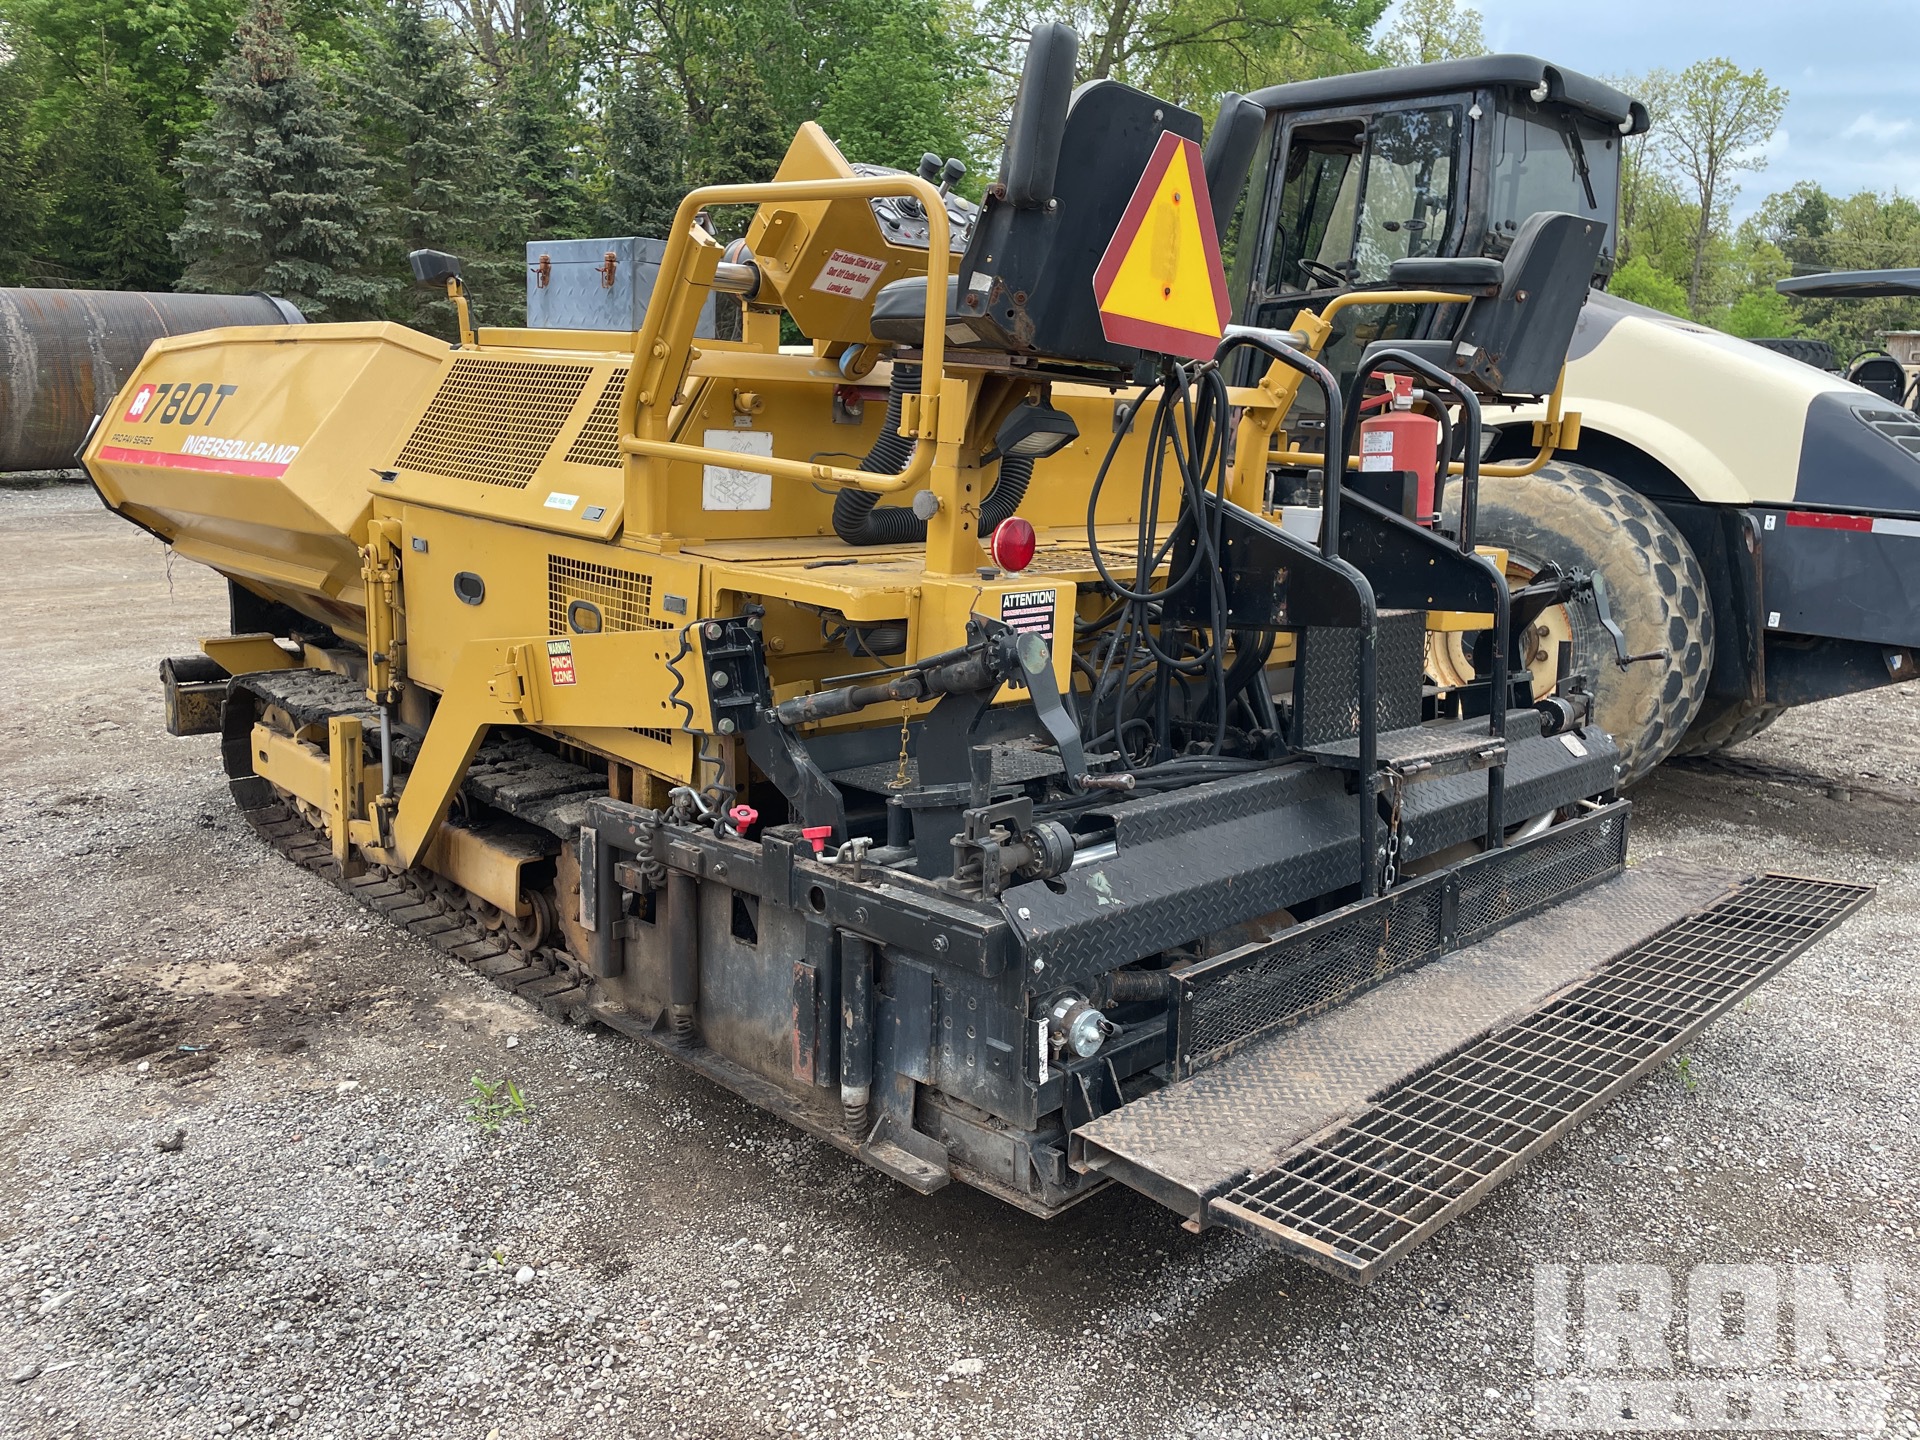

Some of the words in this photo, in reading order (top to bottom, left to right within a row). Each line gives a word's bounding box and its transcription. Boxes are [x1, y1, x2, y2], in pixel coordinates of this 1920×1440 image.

[143, 383, 238, 426] 780T
[180, 434, 300, 464] INGERSOLL-RAND
[1003, 590, 1055, 608] ATTENTION!
[551, 656, 572, 668] PINCH
[554, 670, 573, 683] ZONE
